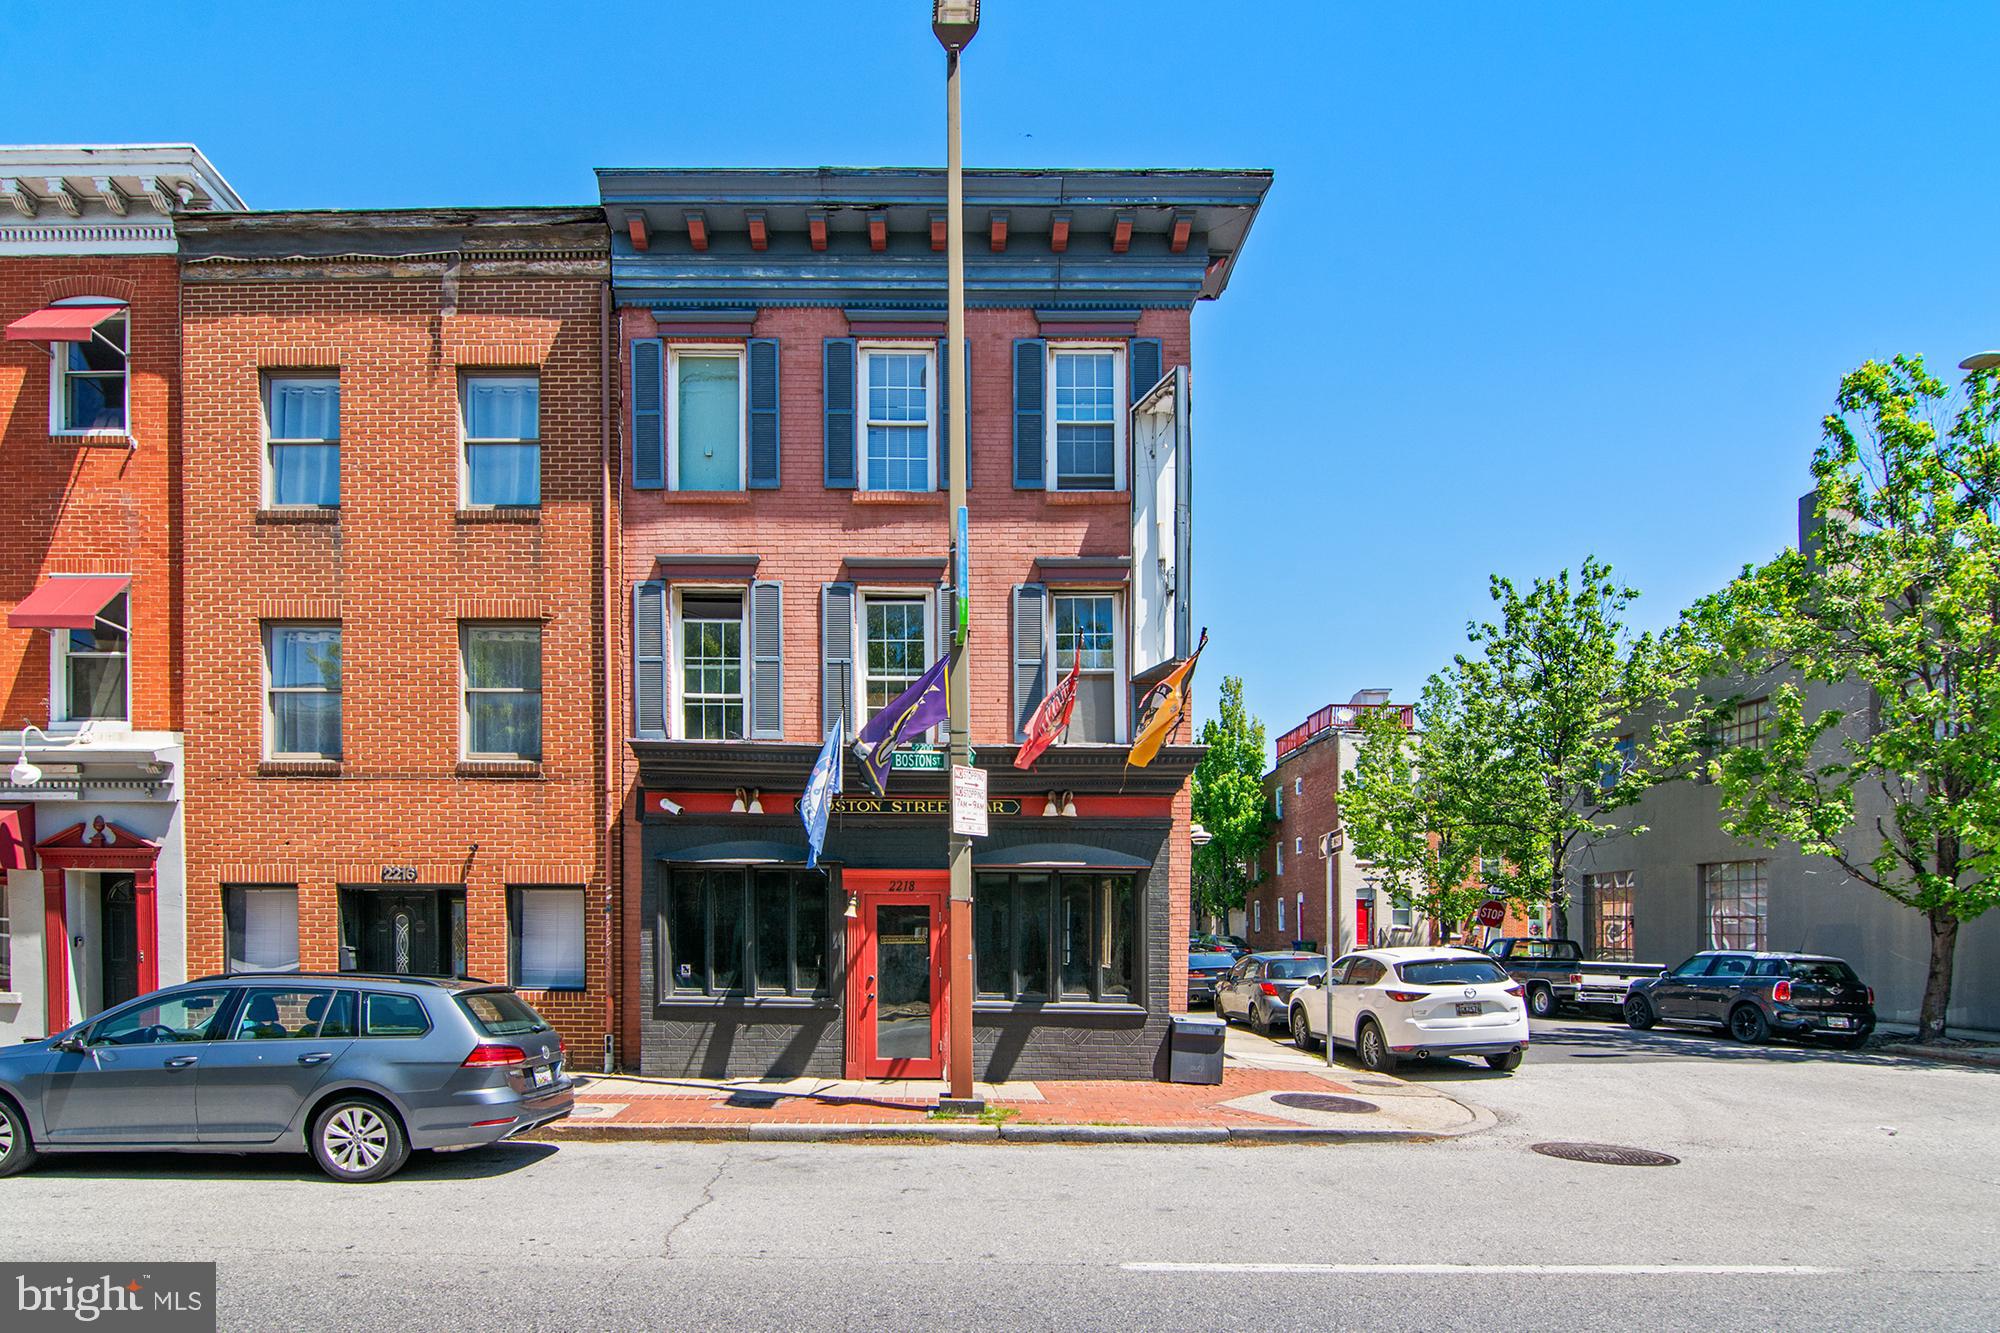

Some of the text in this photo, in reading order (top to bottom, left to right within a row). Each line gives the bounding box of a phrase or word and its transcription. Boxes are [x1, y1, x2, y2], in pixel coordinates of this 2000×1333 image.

[895, 754, 932, 767] BOSTON
[891, 801, 950, 813] STREE
[383, 866, 415, 881] 2216
[888, 880, 916, 892] 2218
[1480, 907, 1504, 920] STOP
